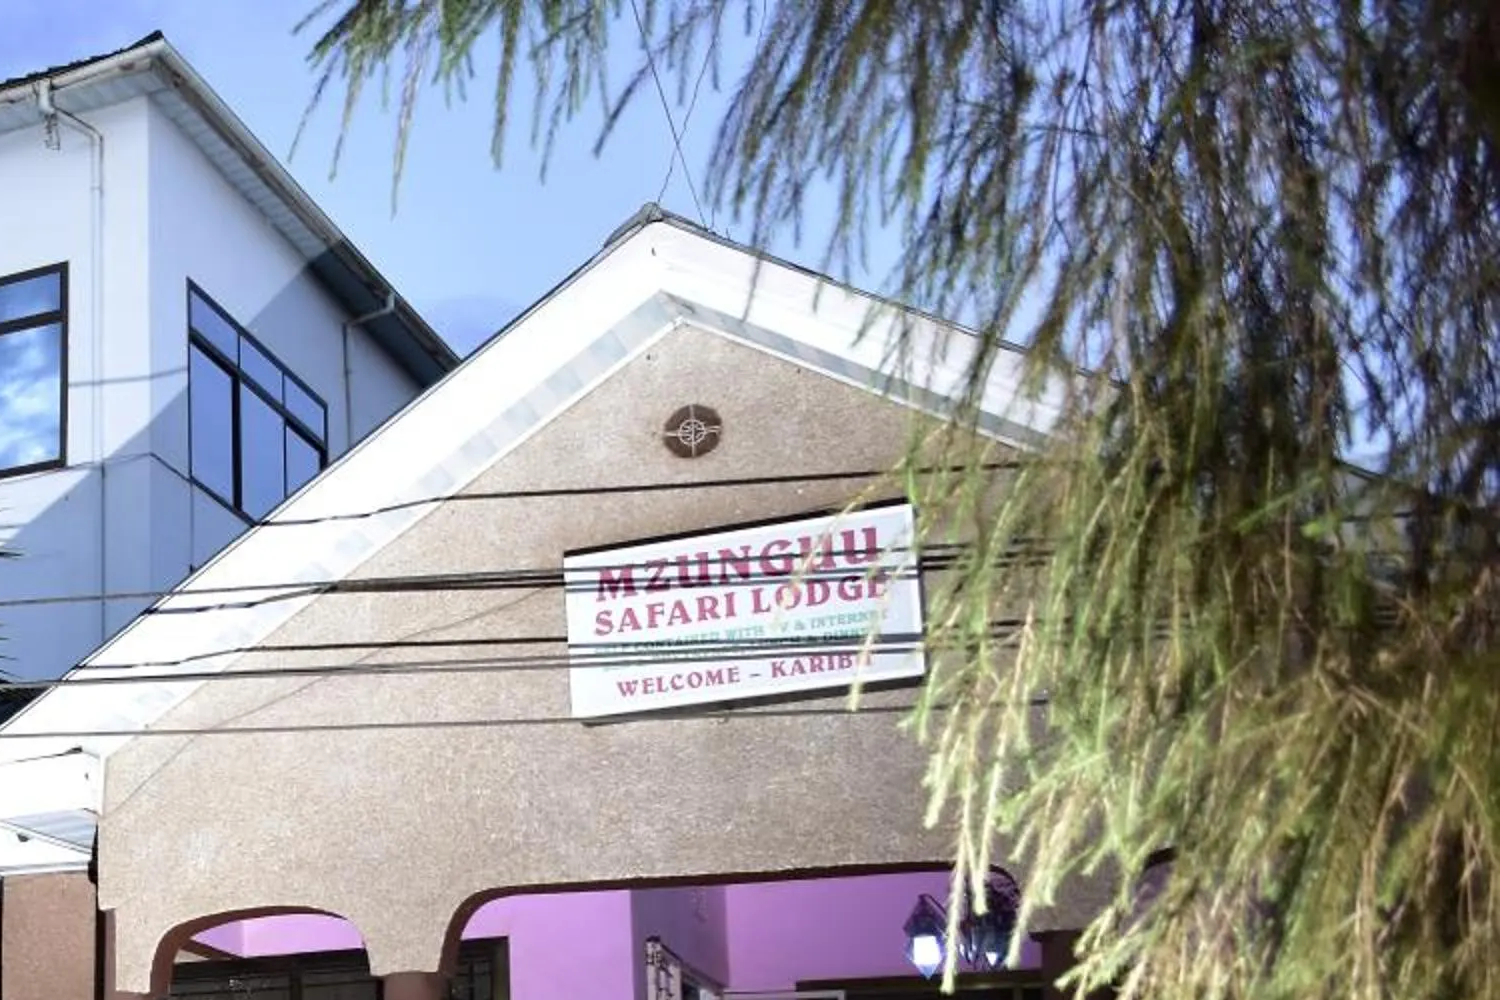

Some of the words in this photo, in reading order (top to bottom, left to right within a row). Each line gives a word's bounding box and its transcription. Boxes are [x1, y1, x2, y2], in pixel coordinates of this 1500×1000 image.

[594, 593, 736, 636] SAFARI
[751, 570, 887, 614] LODGE
[617, 667, 740, 697] WELCOME
[771, 652, 872, 678] KARIB
